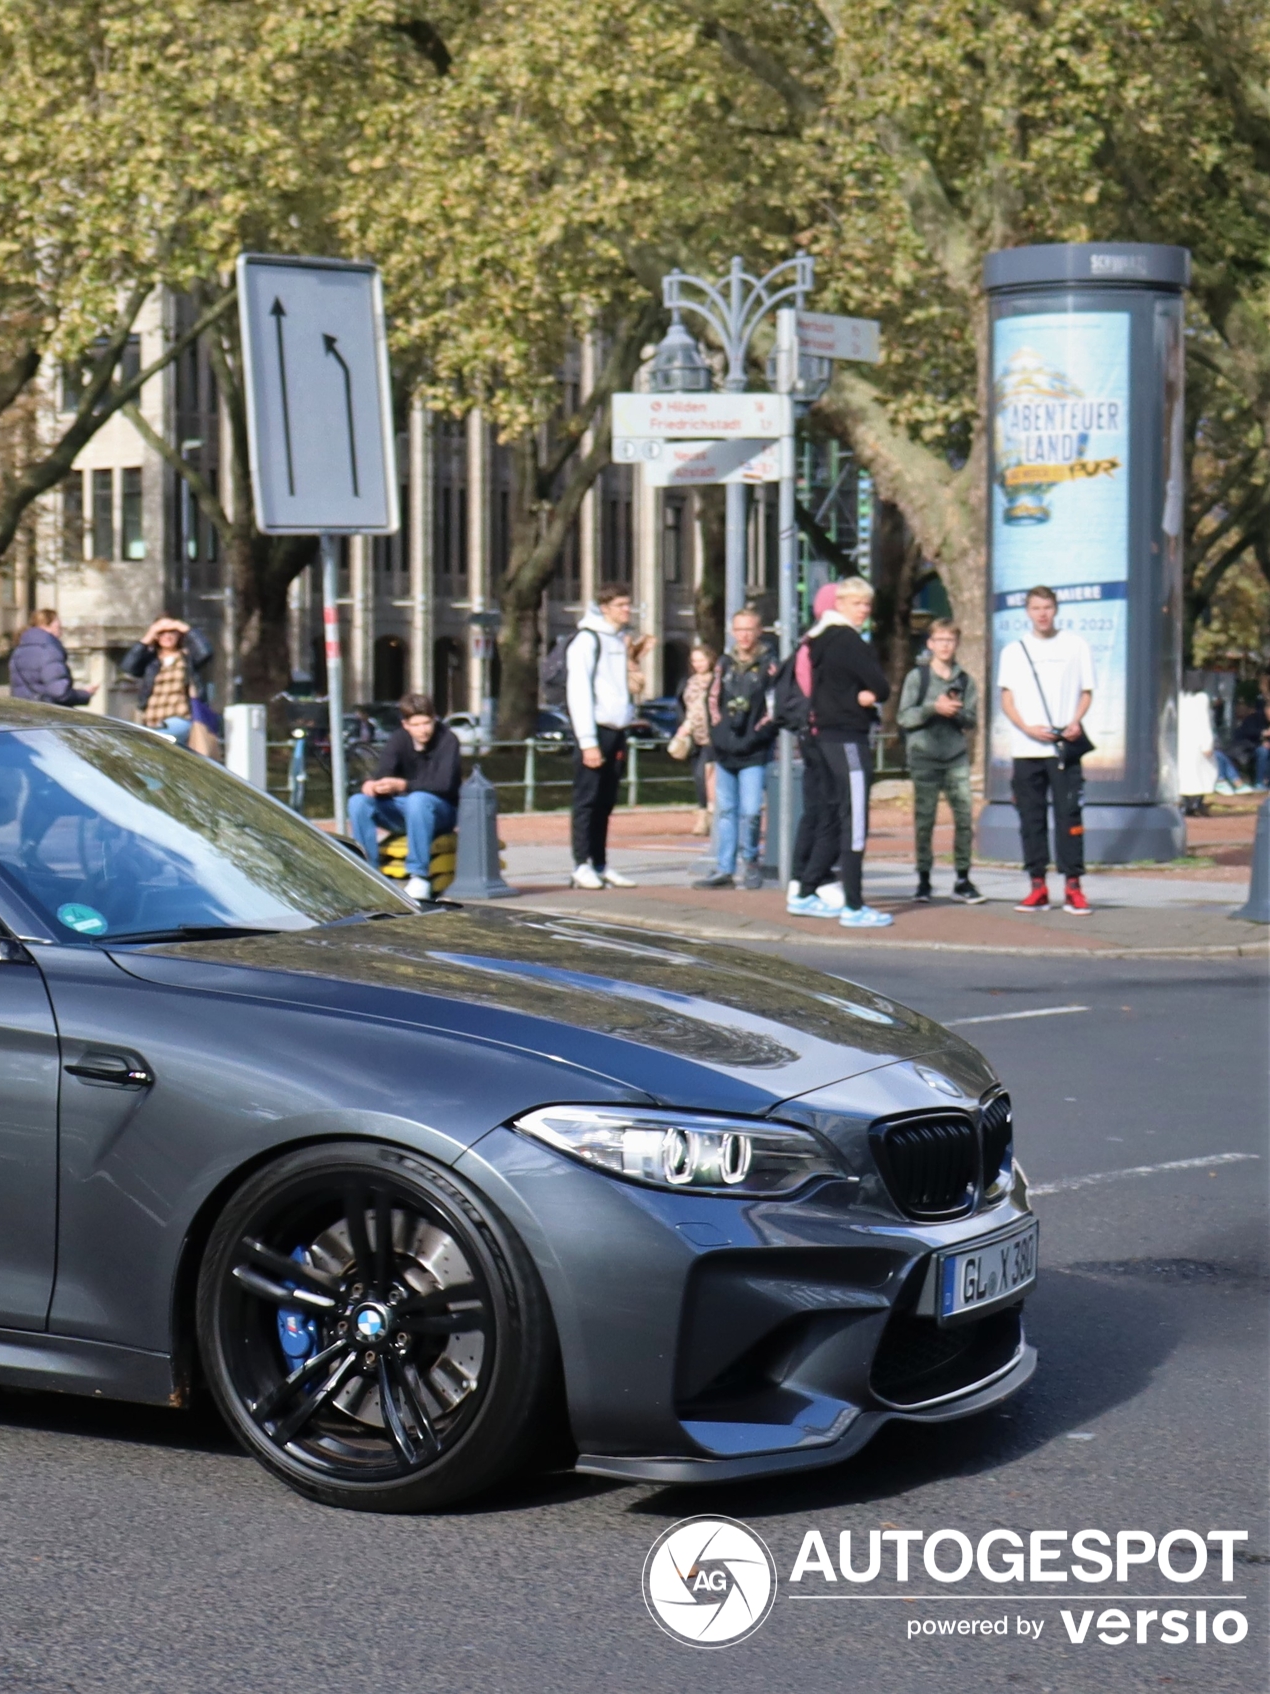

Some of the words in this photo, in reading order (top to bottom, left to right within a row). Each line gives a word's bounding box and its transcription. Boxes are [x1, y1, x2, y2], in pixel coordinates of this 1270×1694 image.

[667, 401, 707, 412] Hilden
[1010, 401, 1118, 431] ABENTEUER
[650, 418, 741, 430] Friedrichstadt
[1025, 434, 1072, 462] LAND
[1079, 618, 1114, 631] 2023
[962, 1256, 987, 1304] GL
[998, 1246, 1010, 1292] X
